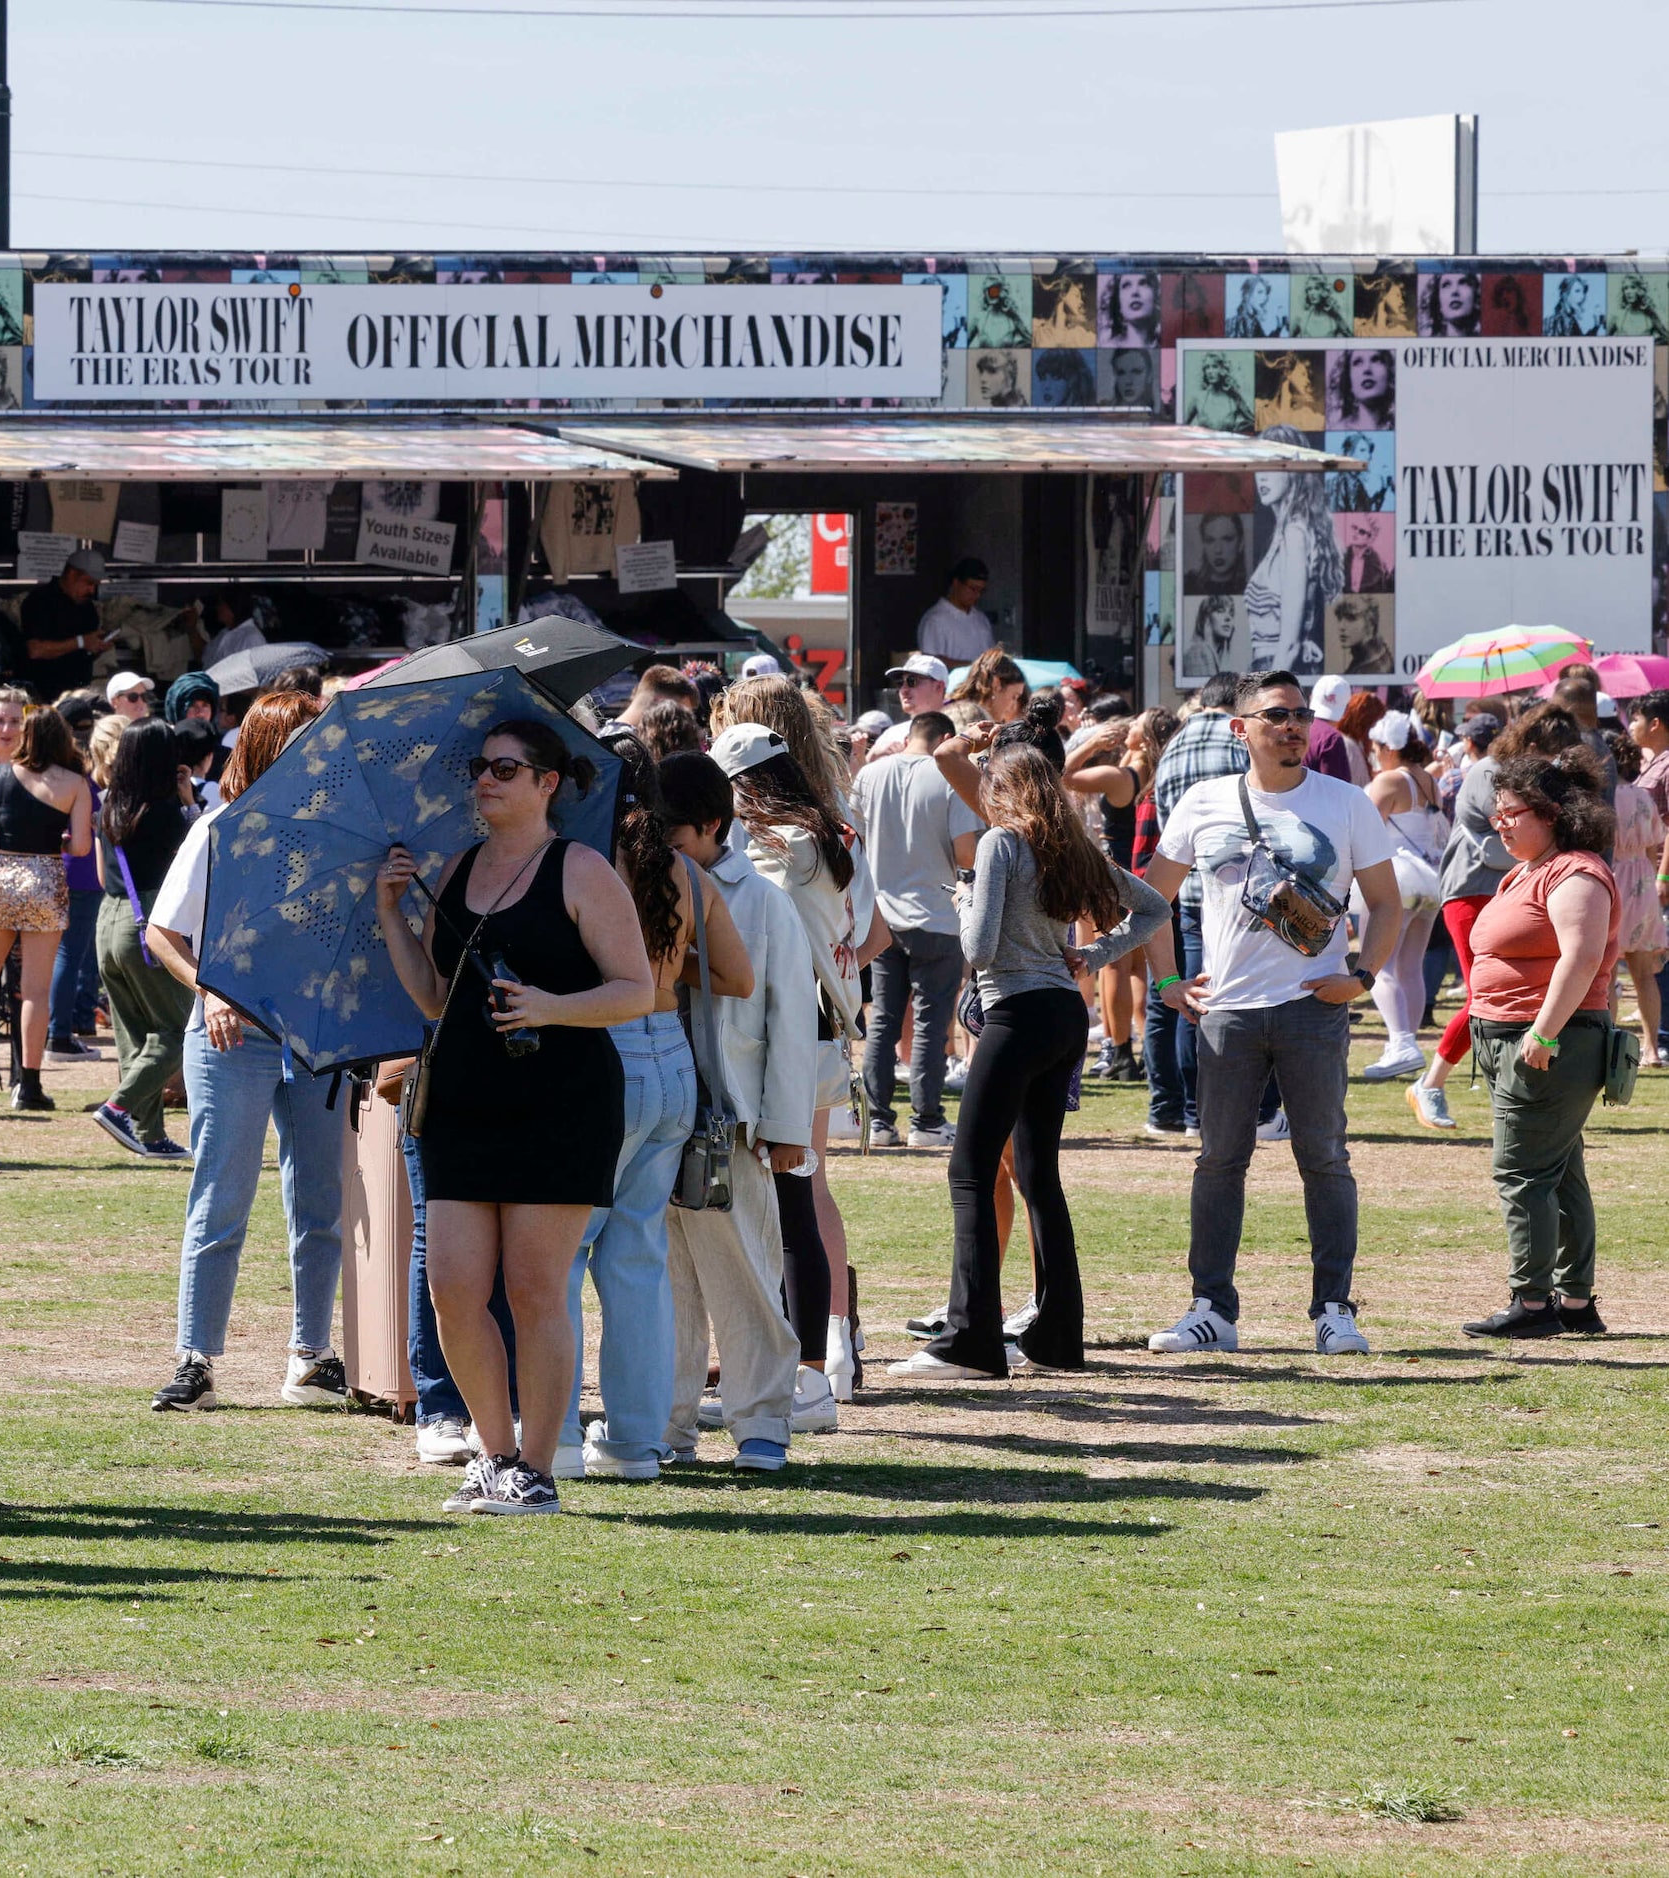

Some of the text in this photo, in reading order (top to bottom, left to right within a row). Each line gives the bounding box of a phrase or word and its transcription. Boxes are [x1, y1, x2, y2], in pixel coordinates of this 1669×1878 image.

[69, 296, 314, 354] TAYLOR SWIFT
[346, 314, 903, 369] OFFICIAL MERCHANDISE
[1403, 345, 1648, 368] OFFICIAL MERCHANDISE
[70, 357, 313, 386] THE ERAS TOUR
[1403, 463, 1646, 525] TAYLOR SWIFT
[365, 518, 409, 539] Youth
[412, 526, 451, 546] Sizes
[1404, 527, 1645, 558] THE ERAS TOUR
[369, 543, 439, 567] Available
